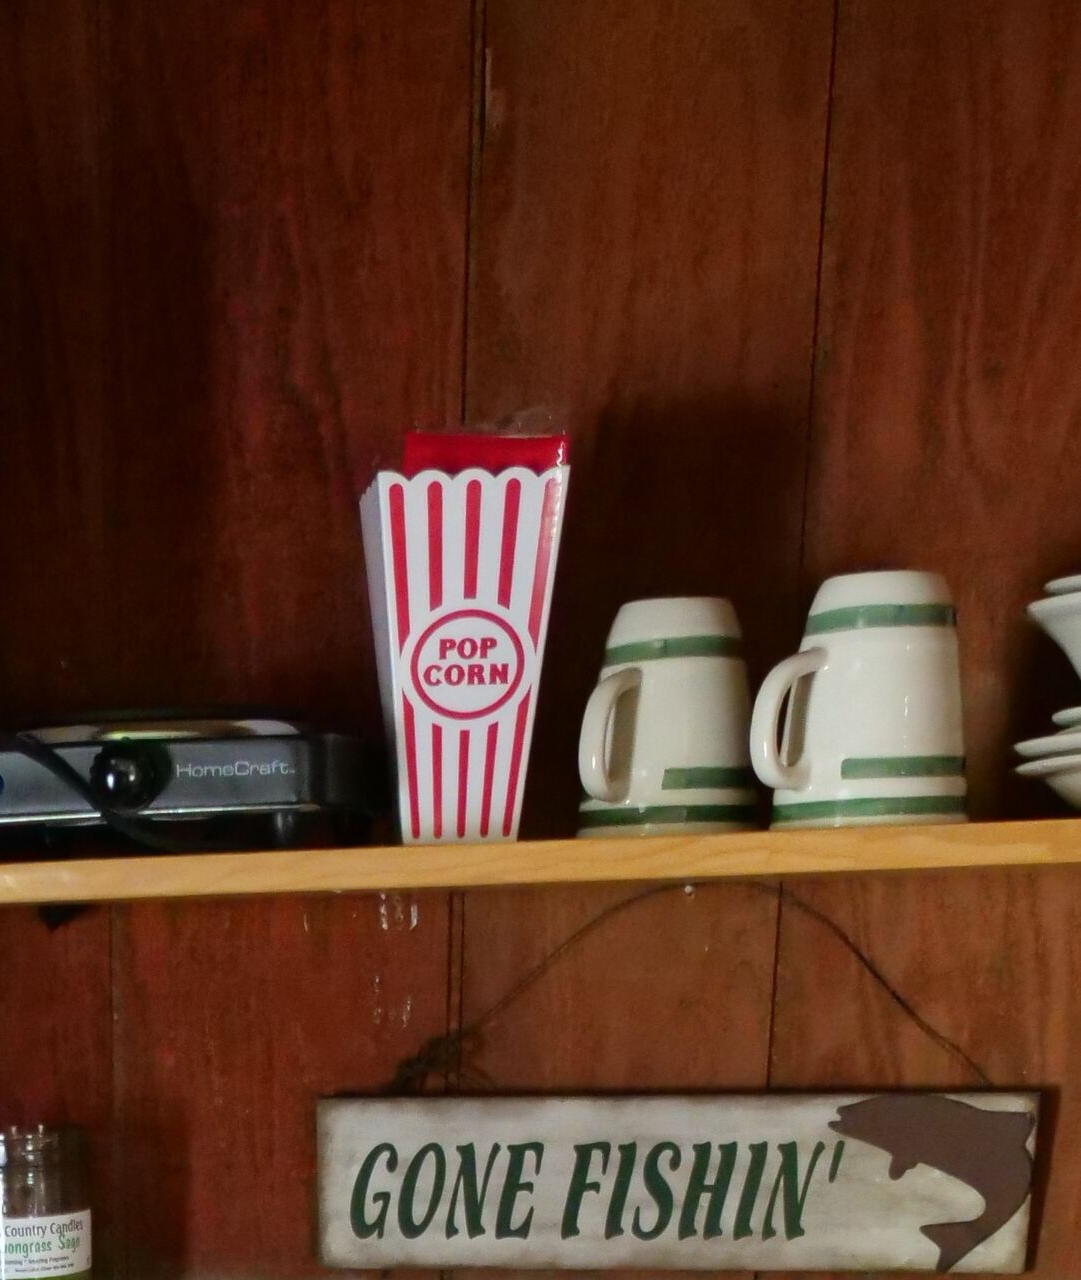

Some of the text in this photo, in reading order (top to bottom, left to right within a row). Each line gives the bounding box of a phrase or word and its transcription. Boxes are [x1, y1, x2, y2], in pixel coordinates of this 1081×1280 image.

[438, 637, 498, 661] POP
[423, 663, 510, 688] CORN
[349, 1138, 845, 1241] GONE FISHIN'
[4, 1225, 47, 1239] Country
[50, 1219, 84, 1235] Candles
[58, 1232, 81, 1252] Sage
